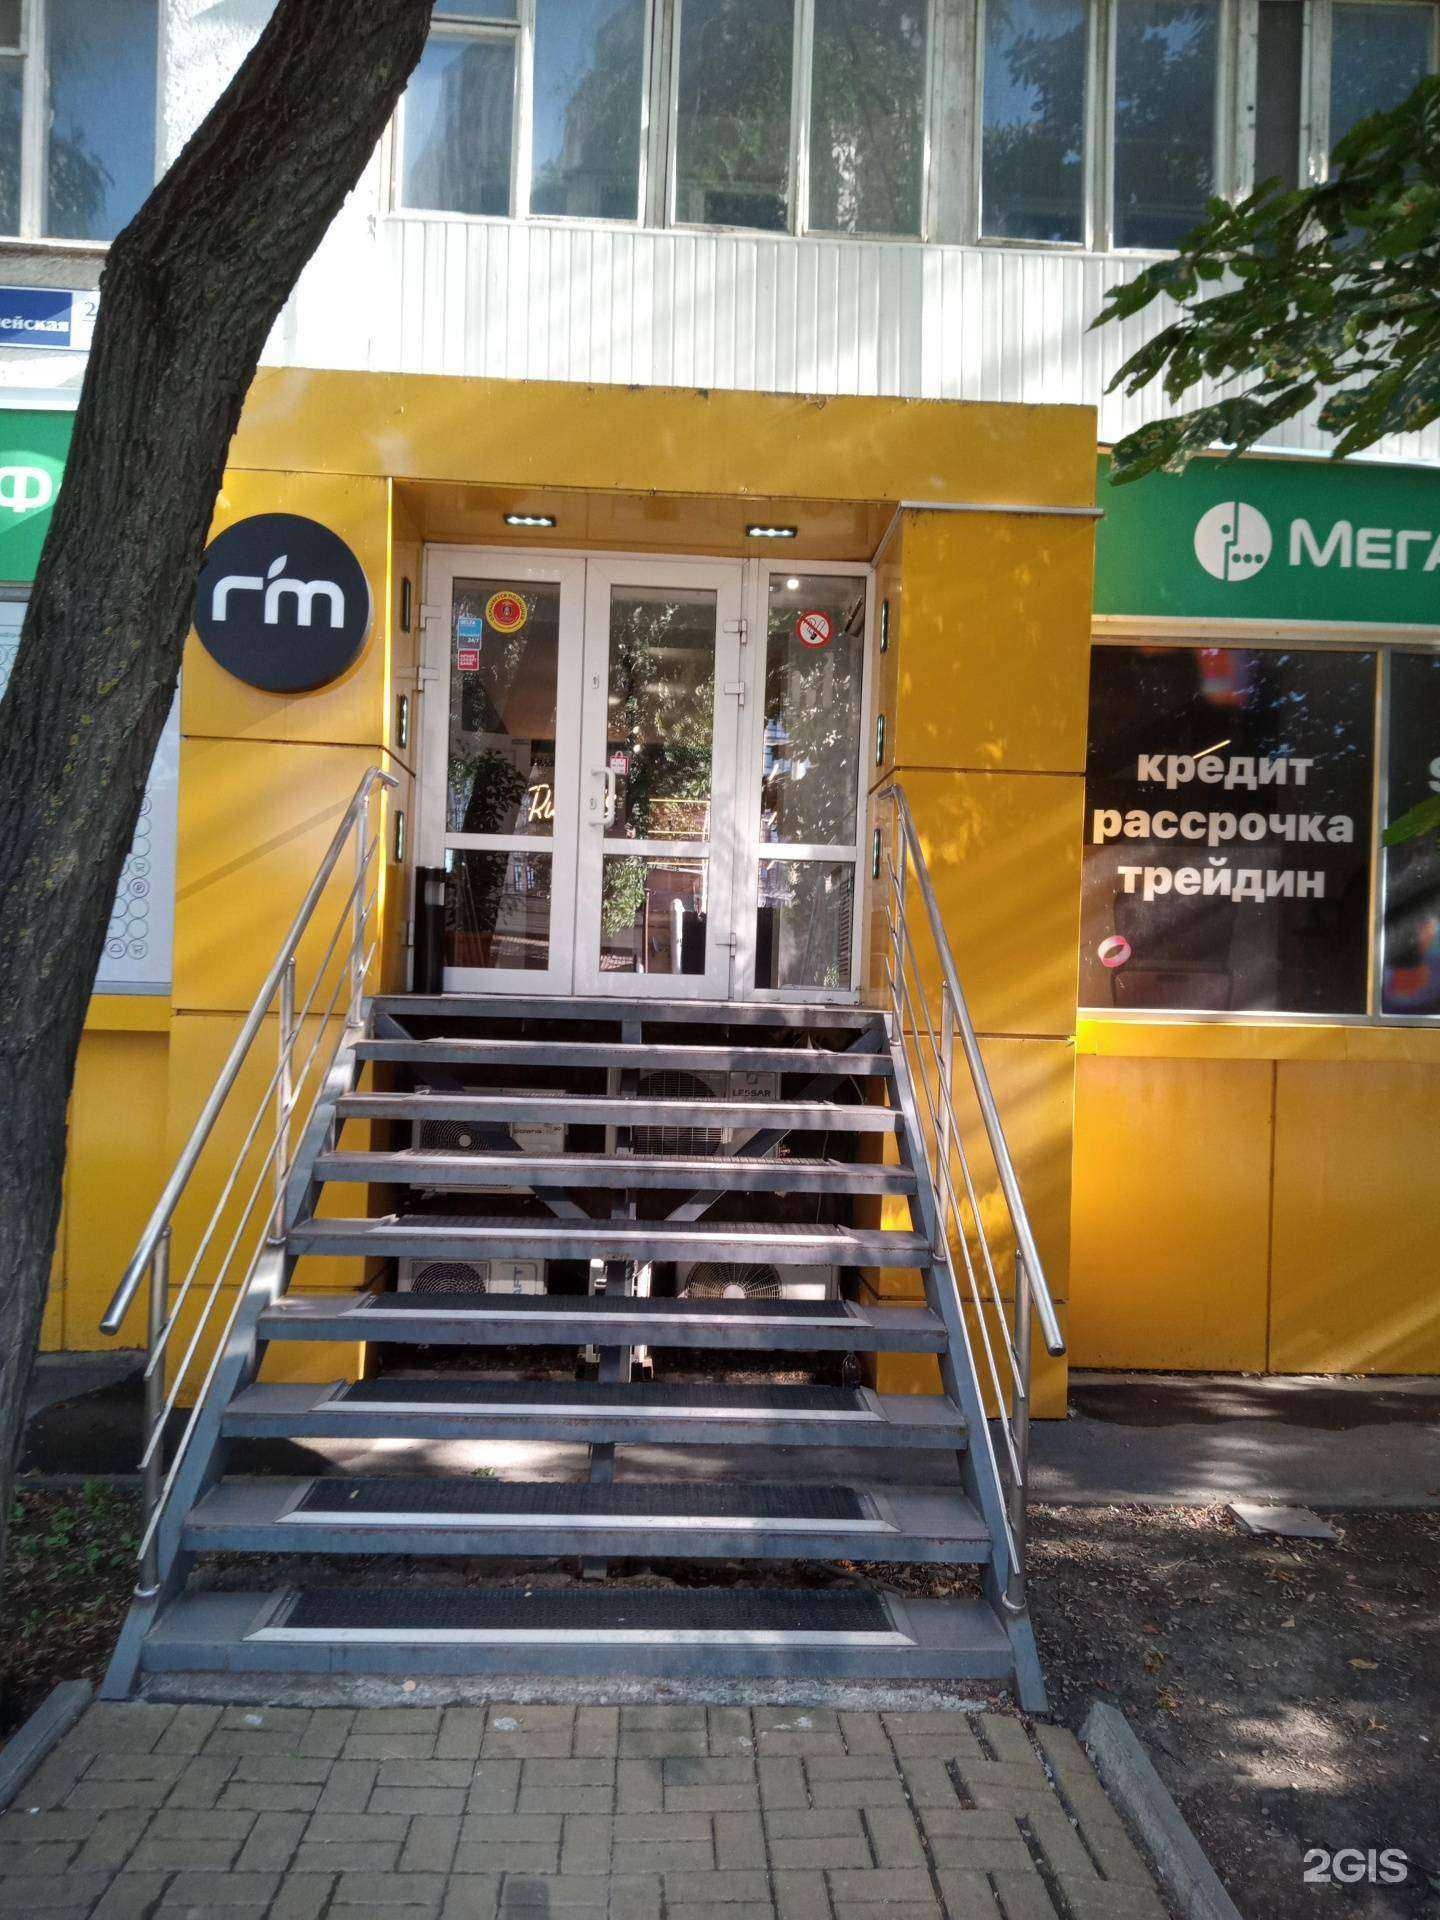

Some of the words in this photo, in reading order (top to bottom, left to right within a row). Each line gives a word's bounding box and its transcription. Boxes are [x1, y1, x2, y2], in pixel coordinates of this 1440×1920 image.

[1137, 753, 1314, 791] кредит
[1093, 809, 1354, 847] рассрочка
[1117, 857, 1326, 903] трейдин
